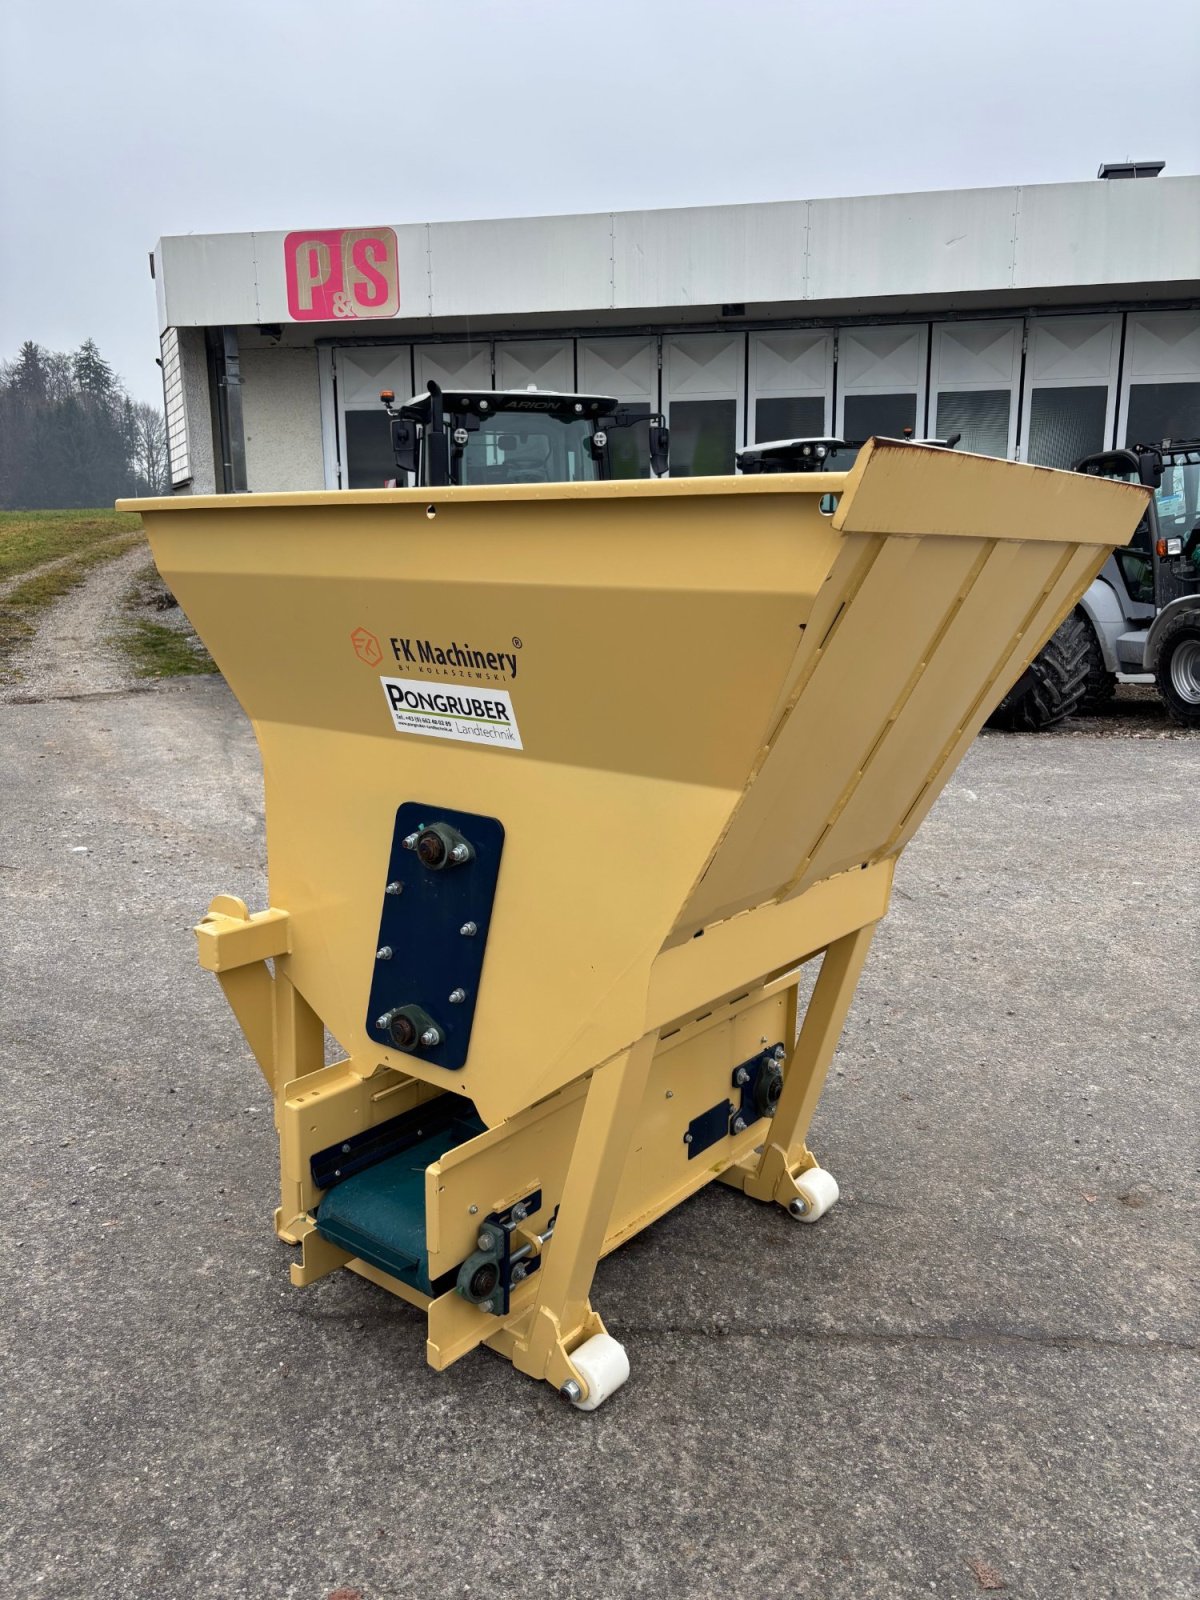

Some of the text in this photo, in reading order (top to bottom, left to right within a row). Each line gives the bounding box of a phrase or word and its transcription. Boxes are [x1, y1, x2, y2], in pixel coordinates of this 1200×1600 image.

[296, 238, 388, 317] P&S
[505, 401, 561, 410] ARION
[352, 638, 377, 658] FK
[390, 638, 416, 663] FK
[398, 664, 411, 672] BY
[455, 721, 516, 741] Landtechnik
